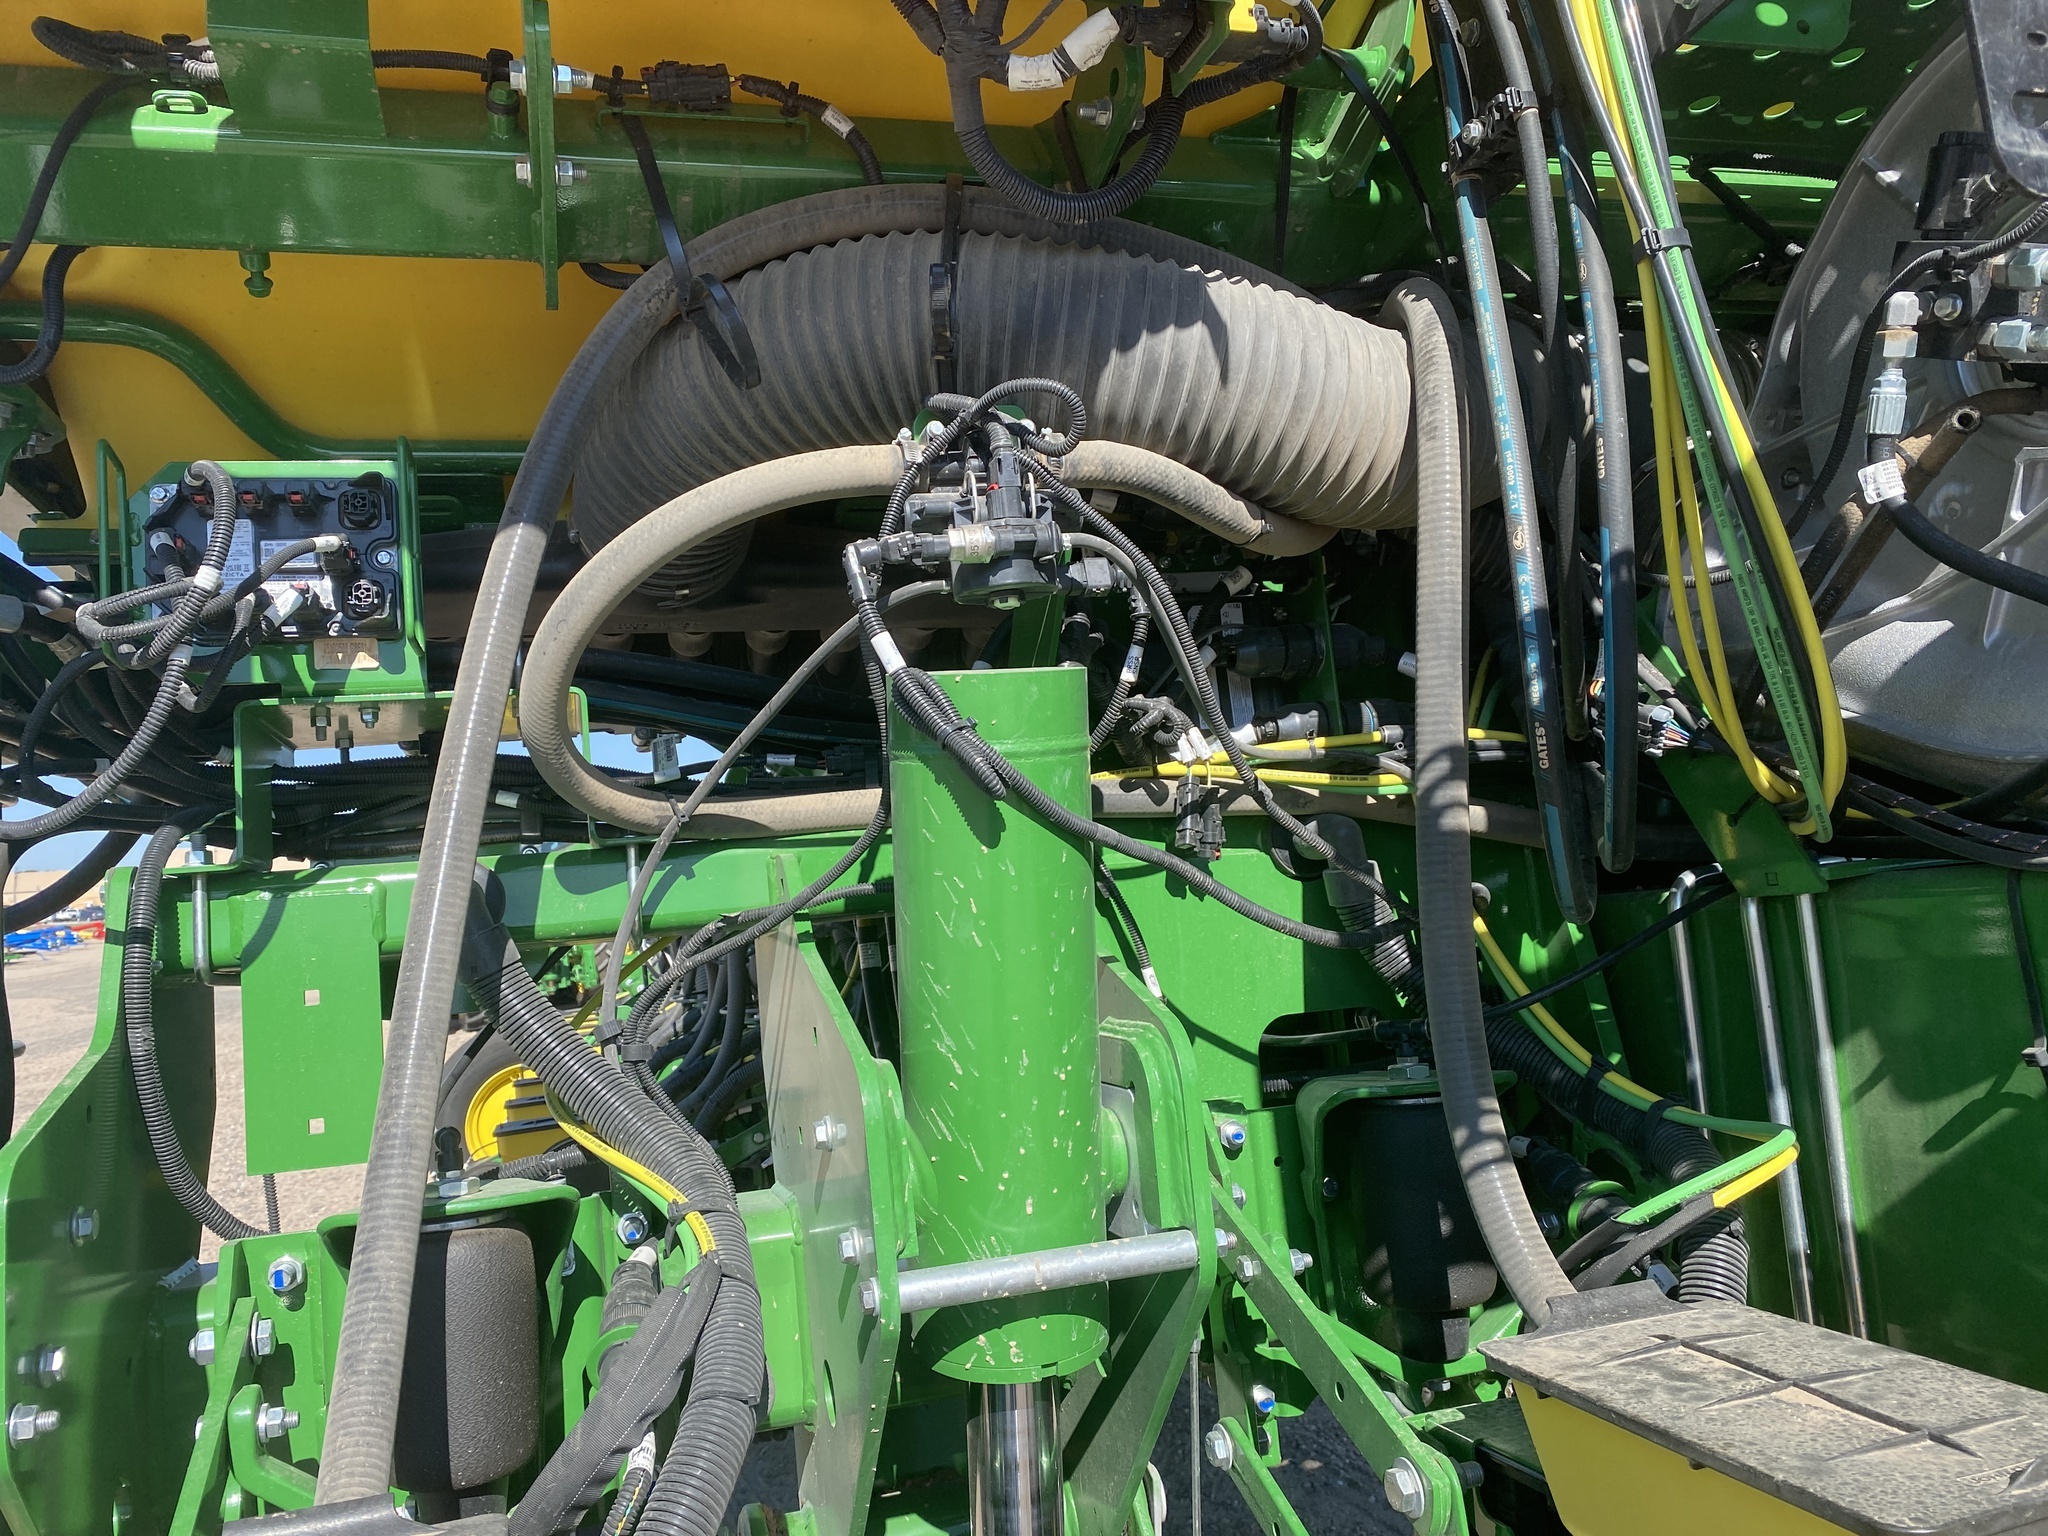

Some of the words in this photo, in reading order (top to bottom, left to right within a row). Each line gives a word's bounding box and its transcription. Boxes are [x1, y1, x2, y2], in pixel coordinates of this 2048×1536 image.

[1475, 270, 1483, 289] MSHA
[1504, 450, 1513, 462] psi
[1596, 437, 1604, 478] GATES
[1506, 464, 1515, 485] 4000
[1521, 595, 1531, 614] MXT
[1527, 662, 1542, 706] MEGASys
[1533, 726, 1550, 769] GATES
